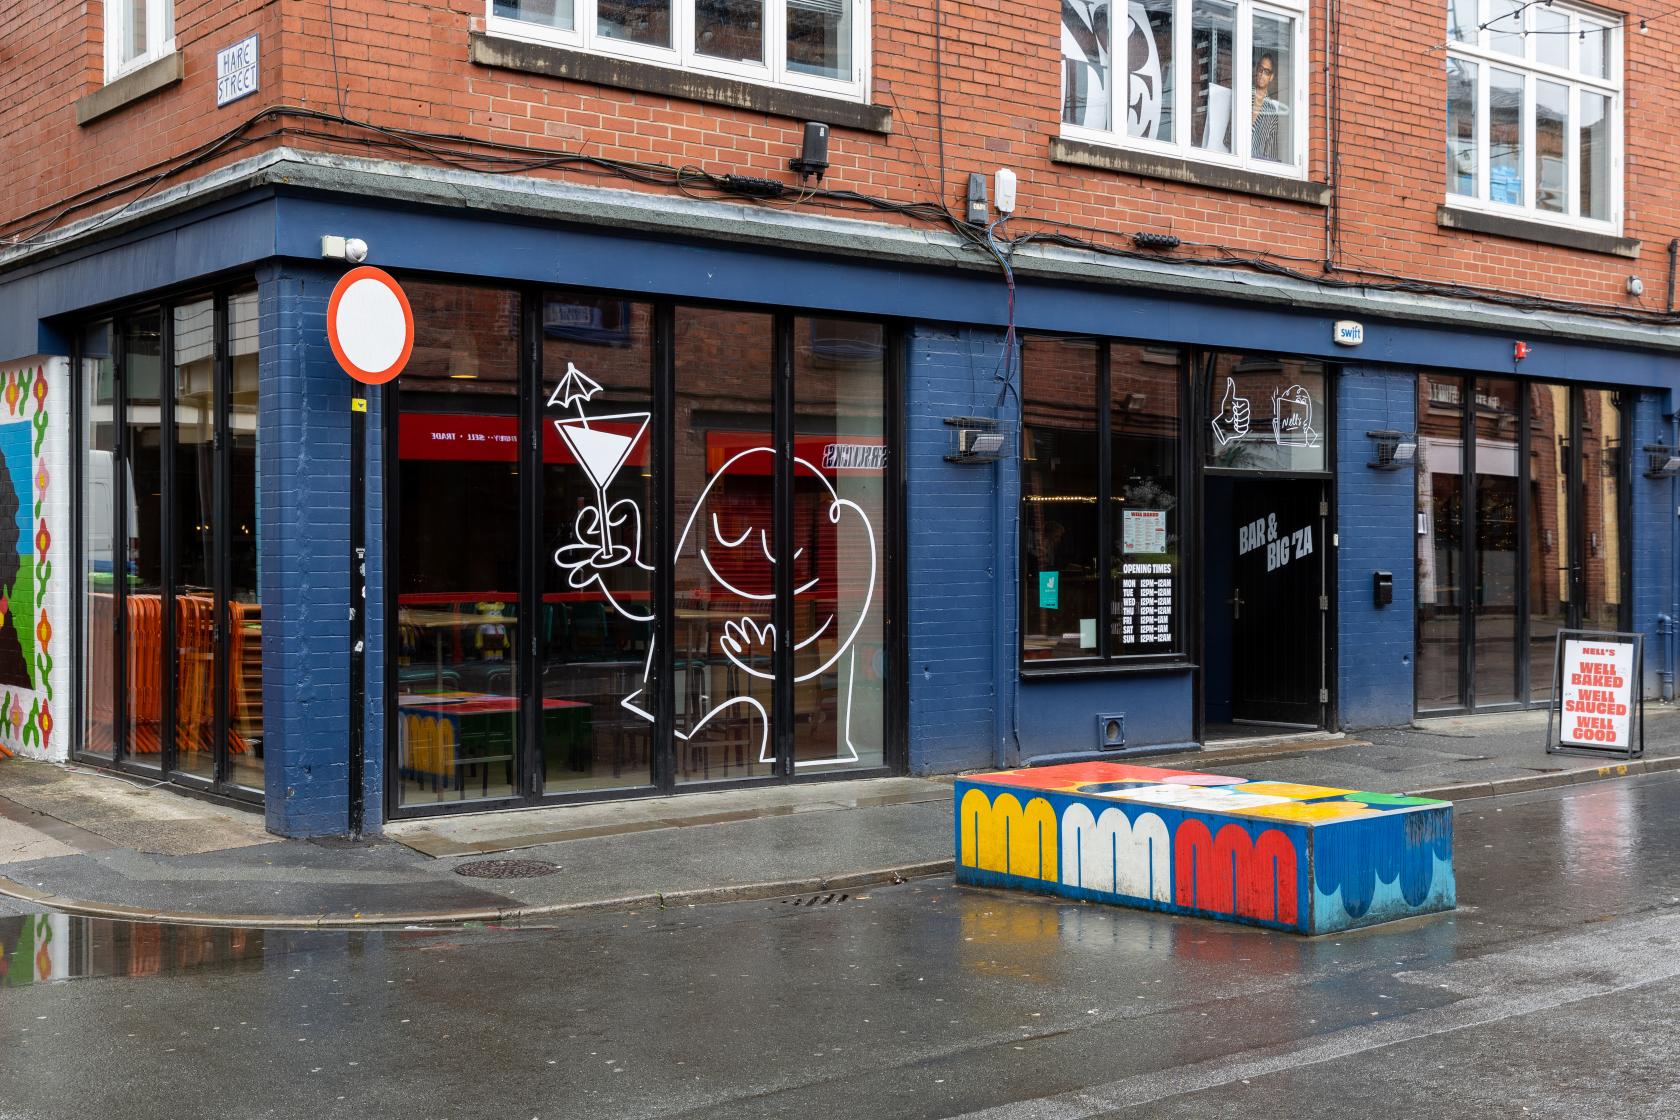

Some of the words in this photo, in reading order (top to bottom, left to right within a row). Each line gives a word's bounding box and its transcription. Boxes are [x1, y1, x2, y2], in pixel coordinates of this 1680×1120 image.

[223, 43, 250, 74] HARE
[218, 64, 256, 101] STREET
[1341, 325, 1360, 340] swift
[1239, 517, 1266, 556] BAR
[1267, 512, 1278, 542] &
[1267, 535, 1290, 572] BIG
[1123, 563, 1152, 574] OPENING
[1152, 563, 1172, 574] TIMES
[1123, 579, 1136, 588] MON
[1123, 588, 1134, 597] TUE
[1123, 597, 1136, 607] WED
[1123, 607, 1135, 616] THU
[1123, 616, 1133, 625] FRI
[1123, 625, 1134, 635] SAT
[1123, 634, 1135, 644] SUN
[1582, 647, 1616, 656] NELL'S
[1579, 662, 1616, 675] WELL
[1571, 673, 1623, 688] BAKED
[1577, 689, 1615, 703] WELL
[1565, 700, 1627, 716] SAUCED
[1576, 716, 1614, 730] WELL
[1572, 727, 1617, 742] GOOD
